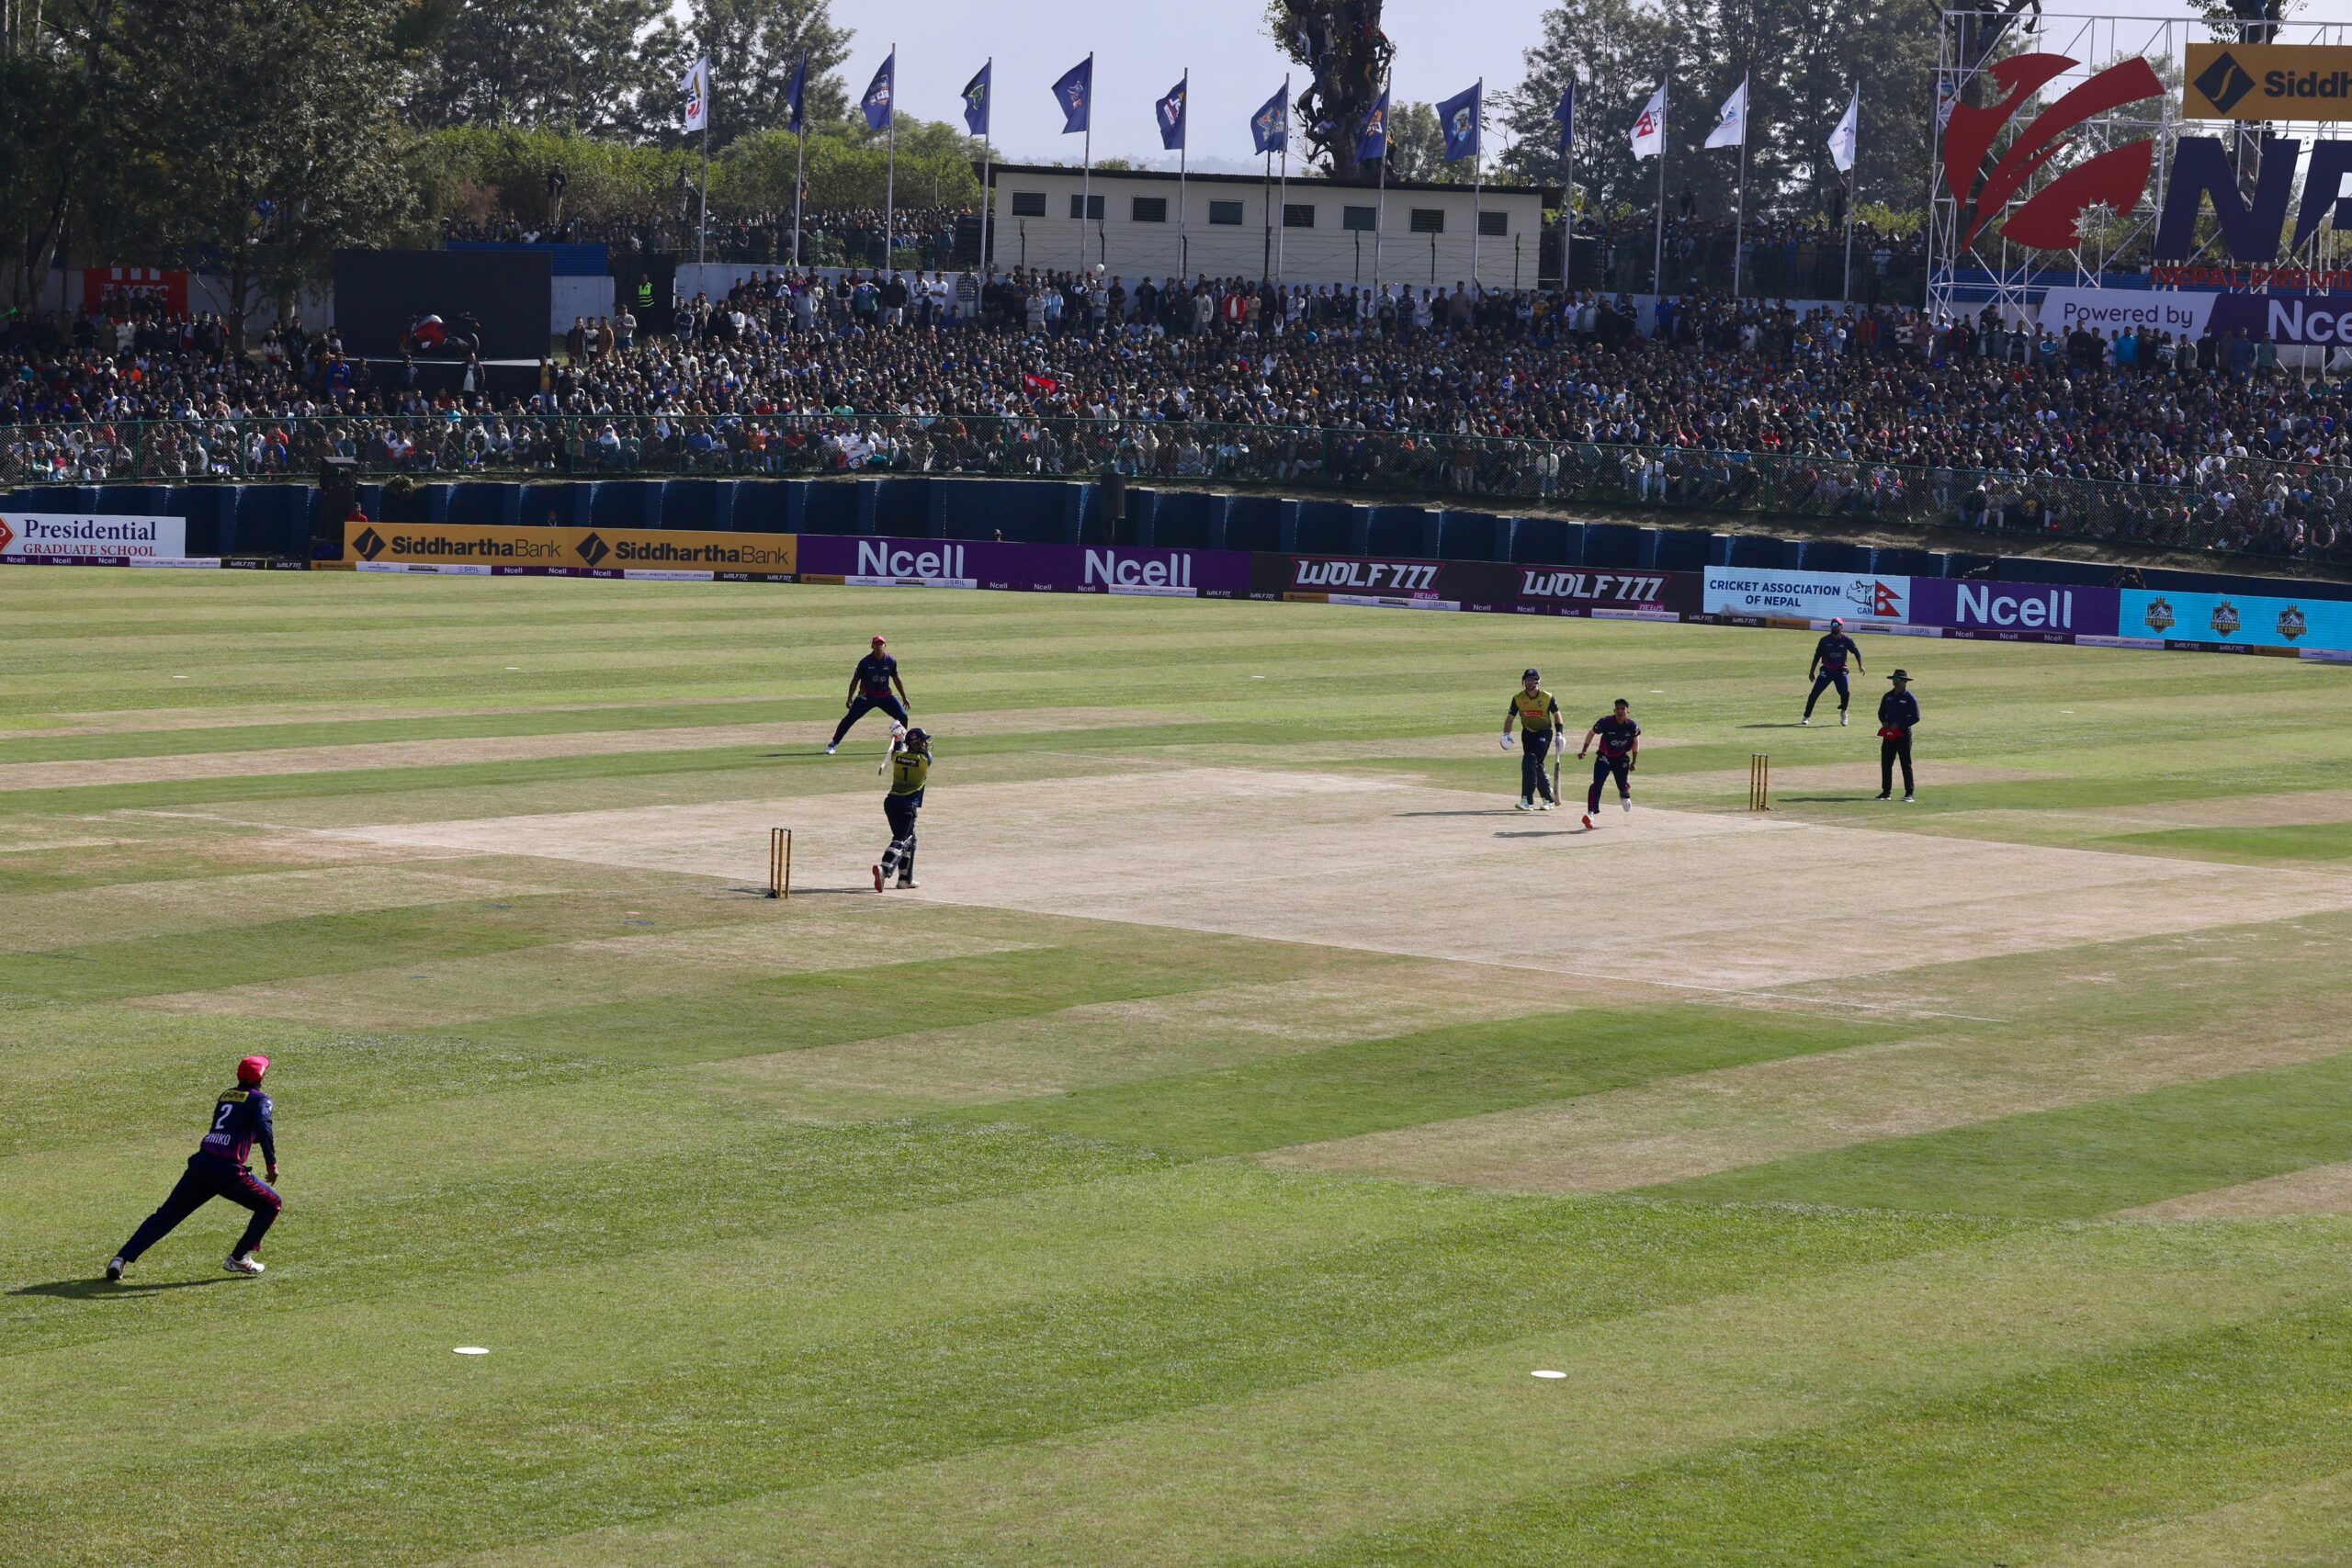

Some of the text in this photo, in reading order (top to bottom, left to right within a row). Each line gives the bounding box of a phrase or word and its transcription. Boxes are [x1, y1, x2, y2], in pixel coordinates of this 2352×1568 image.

[2151, 265, 2246, 288] NEPAL
[2064, 302, 2193, 329] Powered by
[23, 519, 157, 541] Presidential
[23, 544, 156, 557] GRADUATE SCHOOL
[857, 540, 964, 579] Ncell
[1084, 548, 1191, 586] Ncell
[1710, 580, 1841, 596] CRICKET ASSOCIATION
[1746, 594, 1802, 607] OF NEPAL
[1857, 607, 1872, 615] CAN
[1955, 583, 2073, 628] Ncell
[902, 766, 908, 781] 1
[214, 1103, 233, 1130] 2
